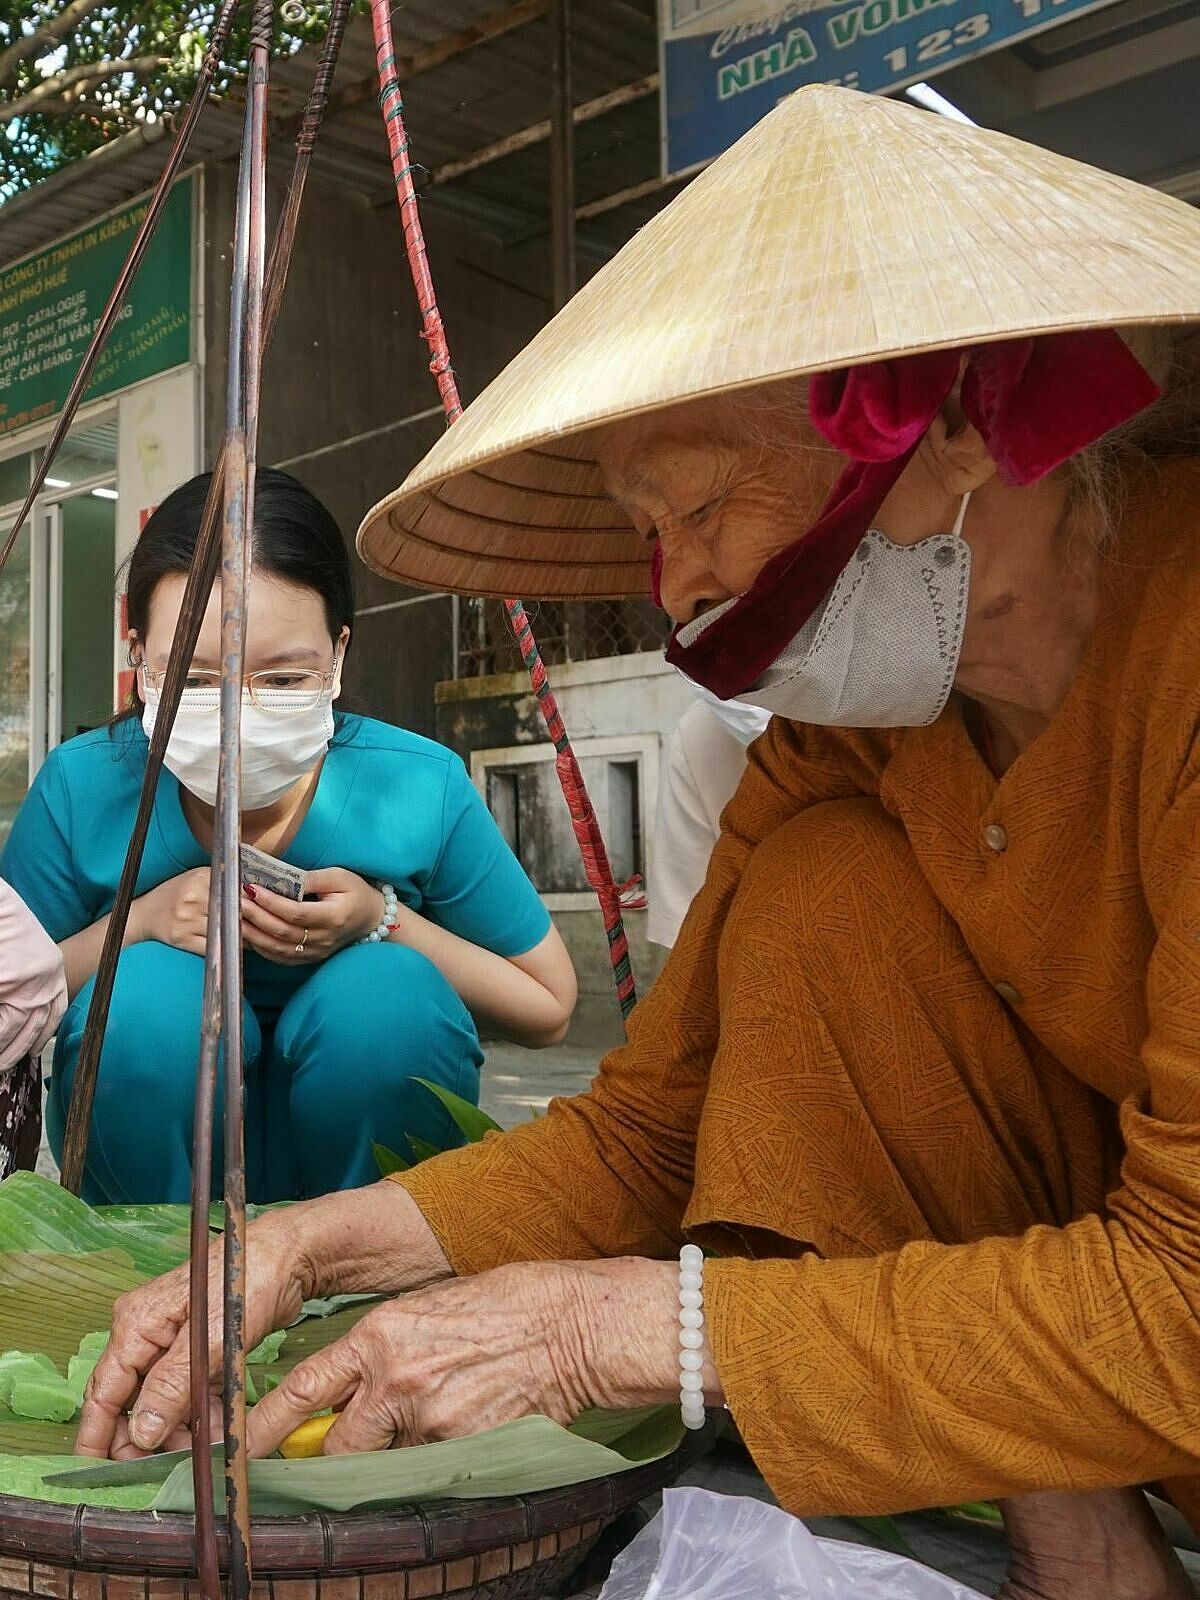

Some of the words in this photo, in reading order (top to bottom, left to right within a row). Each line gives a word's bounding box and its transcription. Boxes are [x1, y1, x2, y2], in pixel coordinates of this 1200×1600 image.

[884, 13, 991, 72] 123
[718, 27, 817, 100] NHÀ
[35, 256, 49, 274] TY
[26, 290, 86, 327] CATALOGUE
[26, 322, 55, 344] DANH
